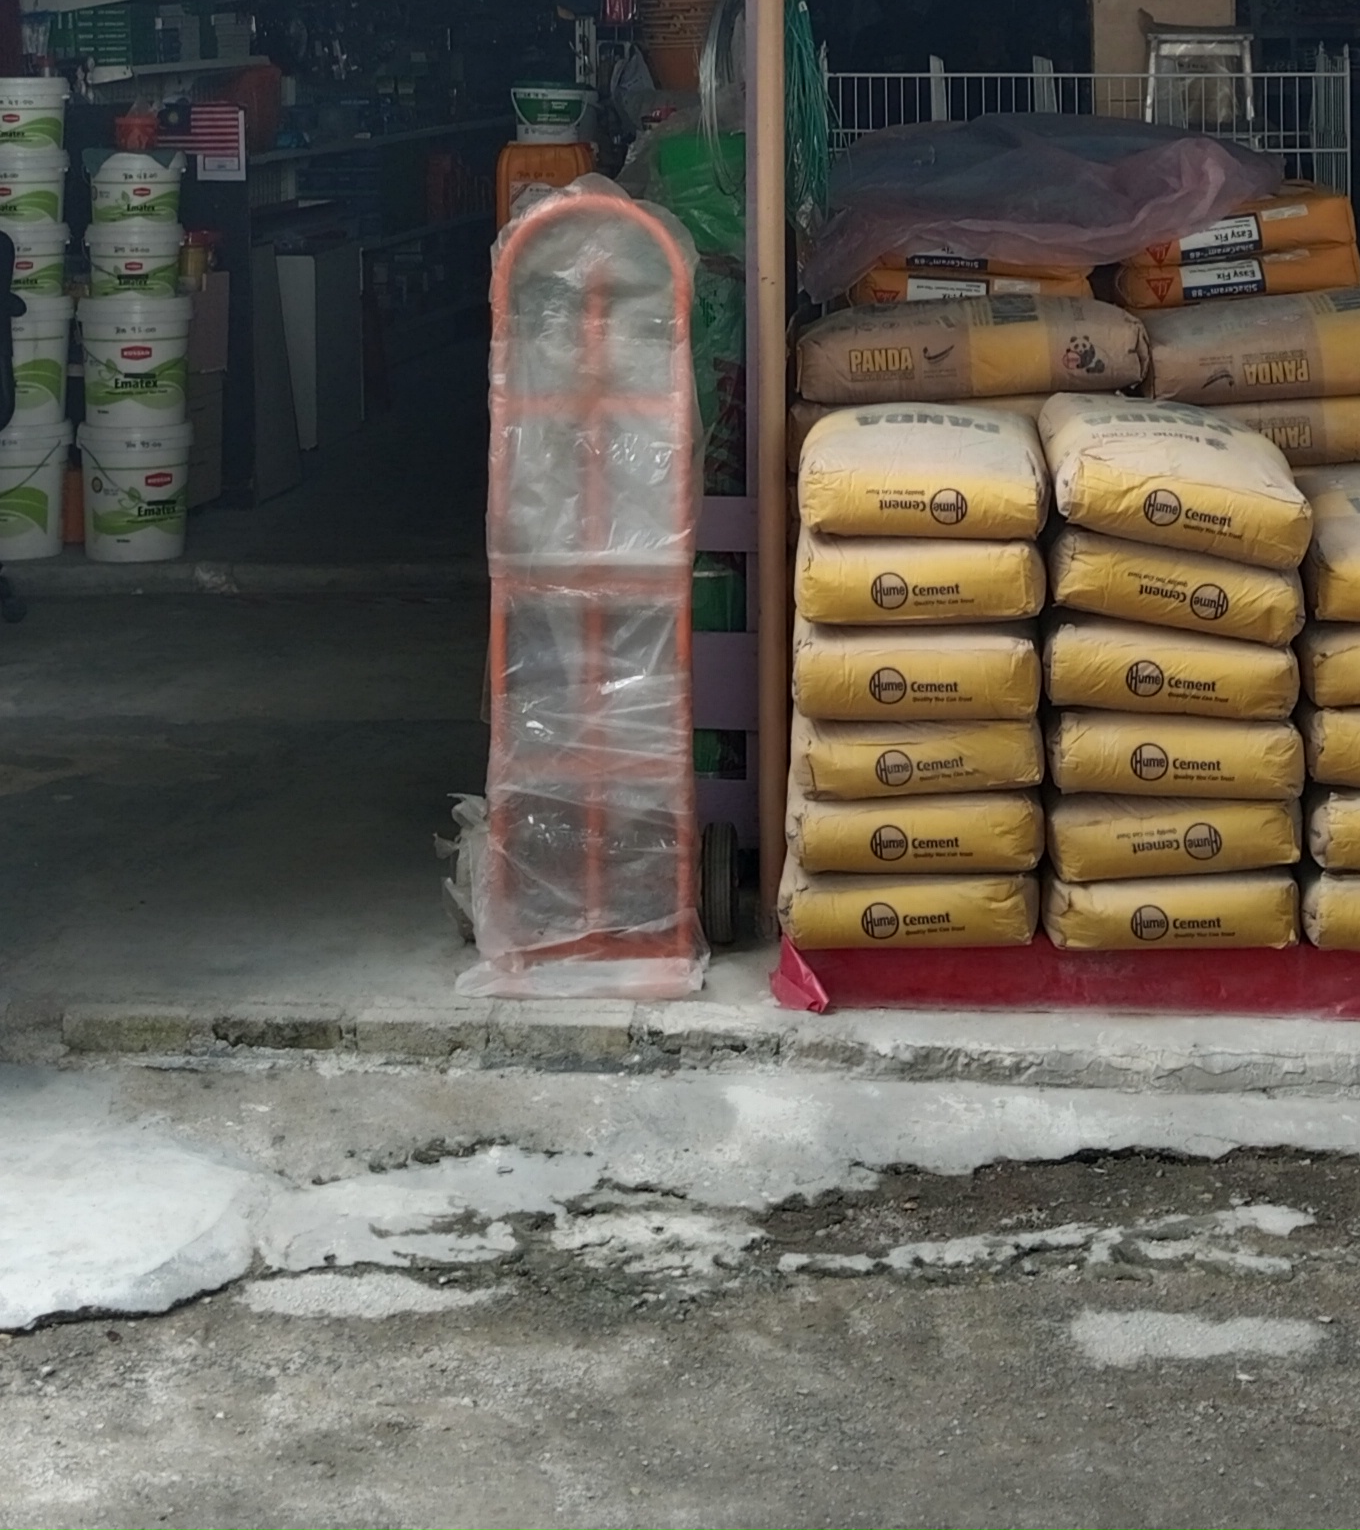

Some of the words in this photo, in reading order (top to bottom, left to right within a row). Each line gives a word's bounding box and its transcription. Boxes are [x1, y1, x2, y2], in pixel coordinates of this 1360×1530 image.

[849, 347, 914, 373] PANDA
[1243, 359, 1310, 386] PANDA
[114, 378, 158, 389] Ematex
[856, 412, 1000, 434] PANDA
[1259, 424, 1312, 449] PAN
[879, 499, 926, 512] Cement
[931, 489, 966, 524] Hume
[1145, 490, 1181, 525] Hume
[1185, 508, 1232, 528] Cement
[872, 573, 907, 608] Hume
[912, 583, 960, 596] Cement
[1139, 584, 1186, 603] Cement
[1191, 585, 1227, 619] Hume
[870, 668, 906, 703] Hume
[910, 681, 958, 693] Cement
[1127, 661, 1163, 696] Hume
[1167, 676, 1216, 692] Cement
[876, 751, 912, 786] Hume
[916, 756, 964, 771] Cement
[1131, 744, 1167, 780] Hume
[1173, 758, 1221, 771] Cement
[872, 826, 907, 860] Hume
[911, 837, 959, 849] Cement
[1132, 839, 1180, 854] Cement
[1185, 824, 1221, 859] Hume
[863, 903, 898, 938] Hume
[903, 912, 951, 925] Cement
[1132, 906, 1168, 940] Hume
[1173, 918, 1221, 929] Cement
